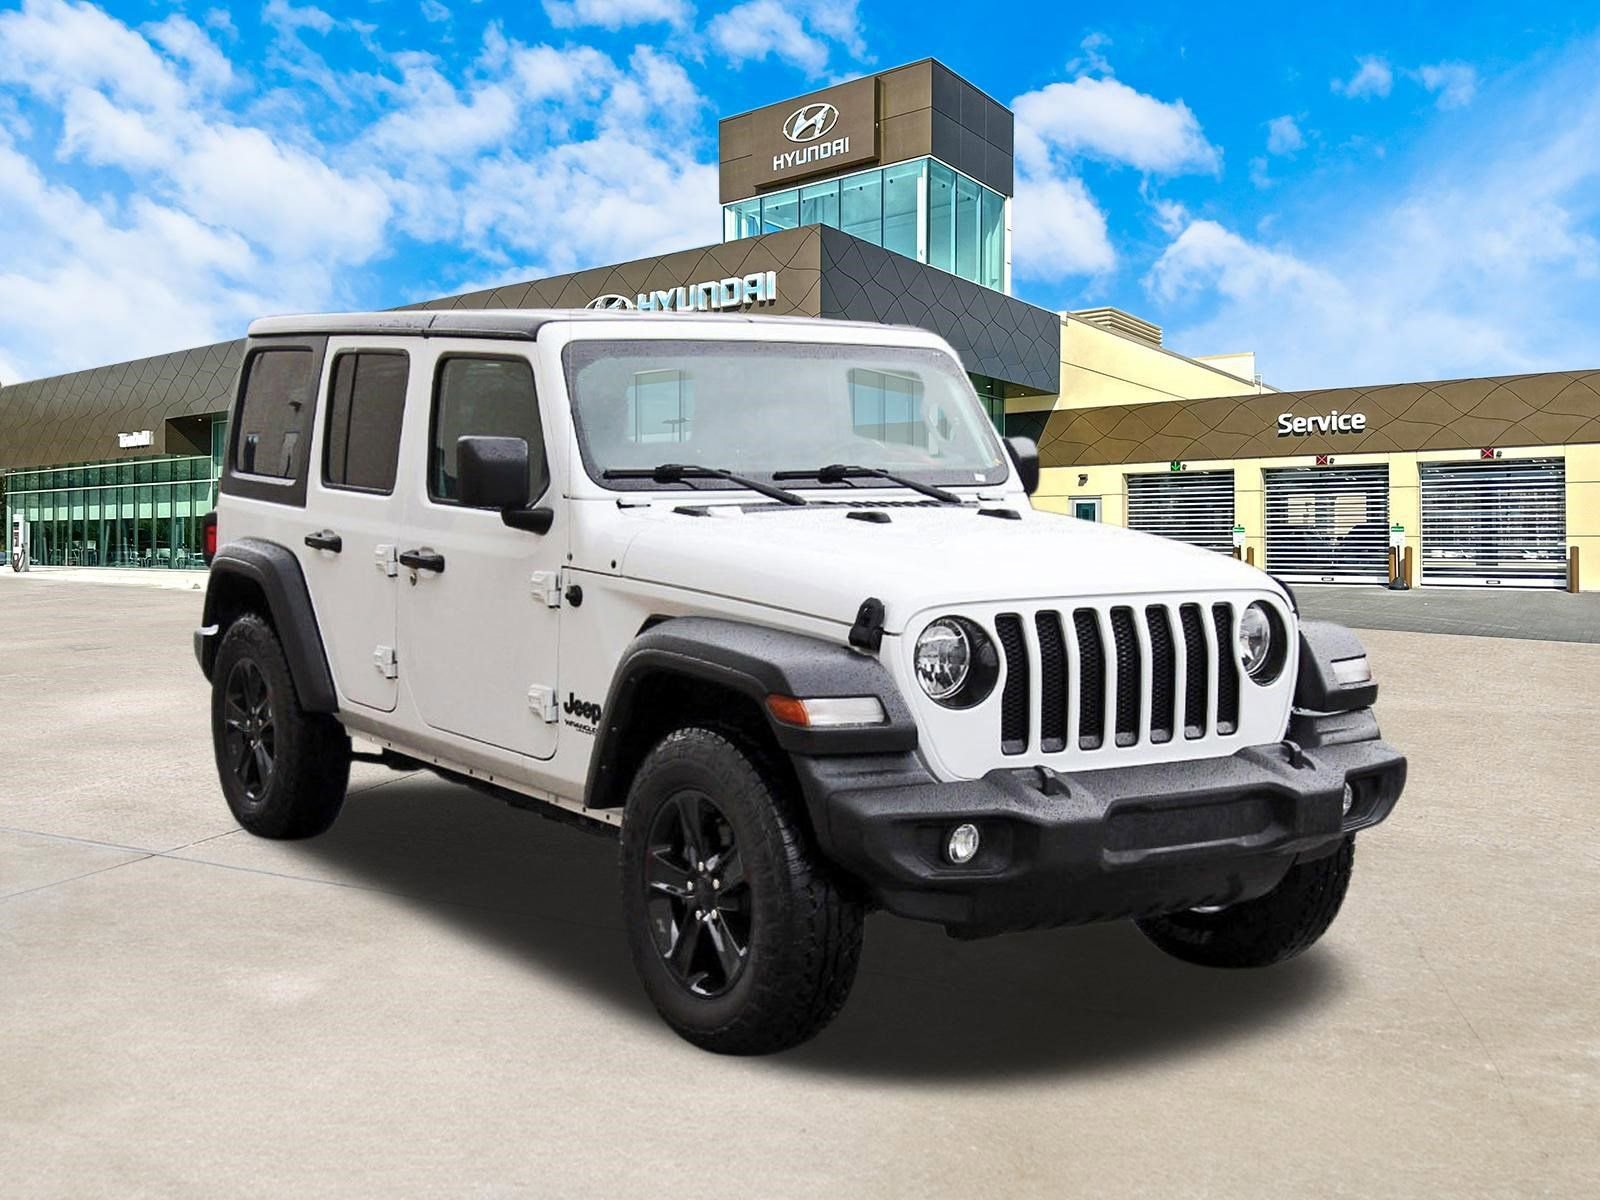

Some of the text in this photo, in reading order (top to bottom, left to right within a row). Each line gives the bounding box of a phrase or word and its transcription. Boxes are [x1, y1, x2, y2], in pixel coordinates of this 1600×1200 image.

[773, 137, 849, 171] HYUNDAI
[637, 271, 777, 312] HYUNDAI
[1278, 410, 1366, 435] Service
[564, 692, 602, 726] Jeep
